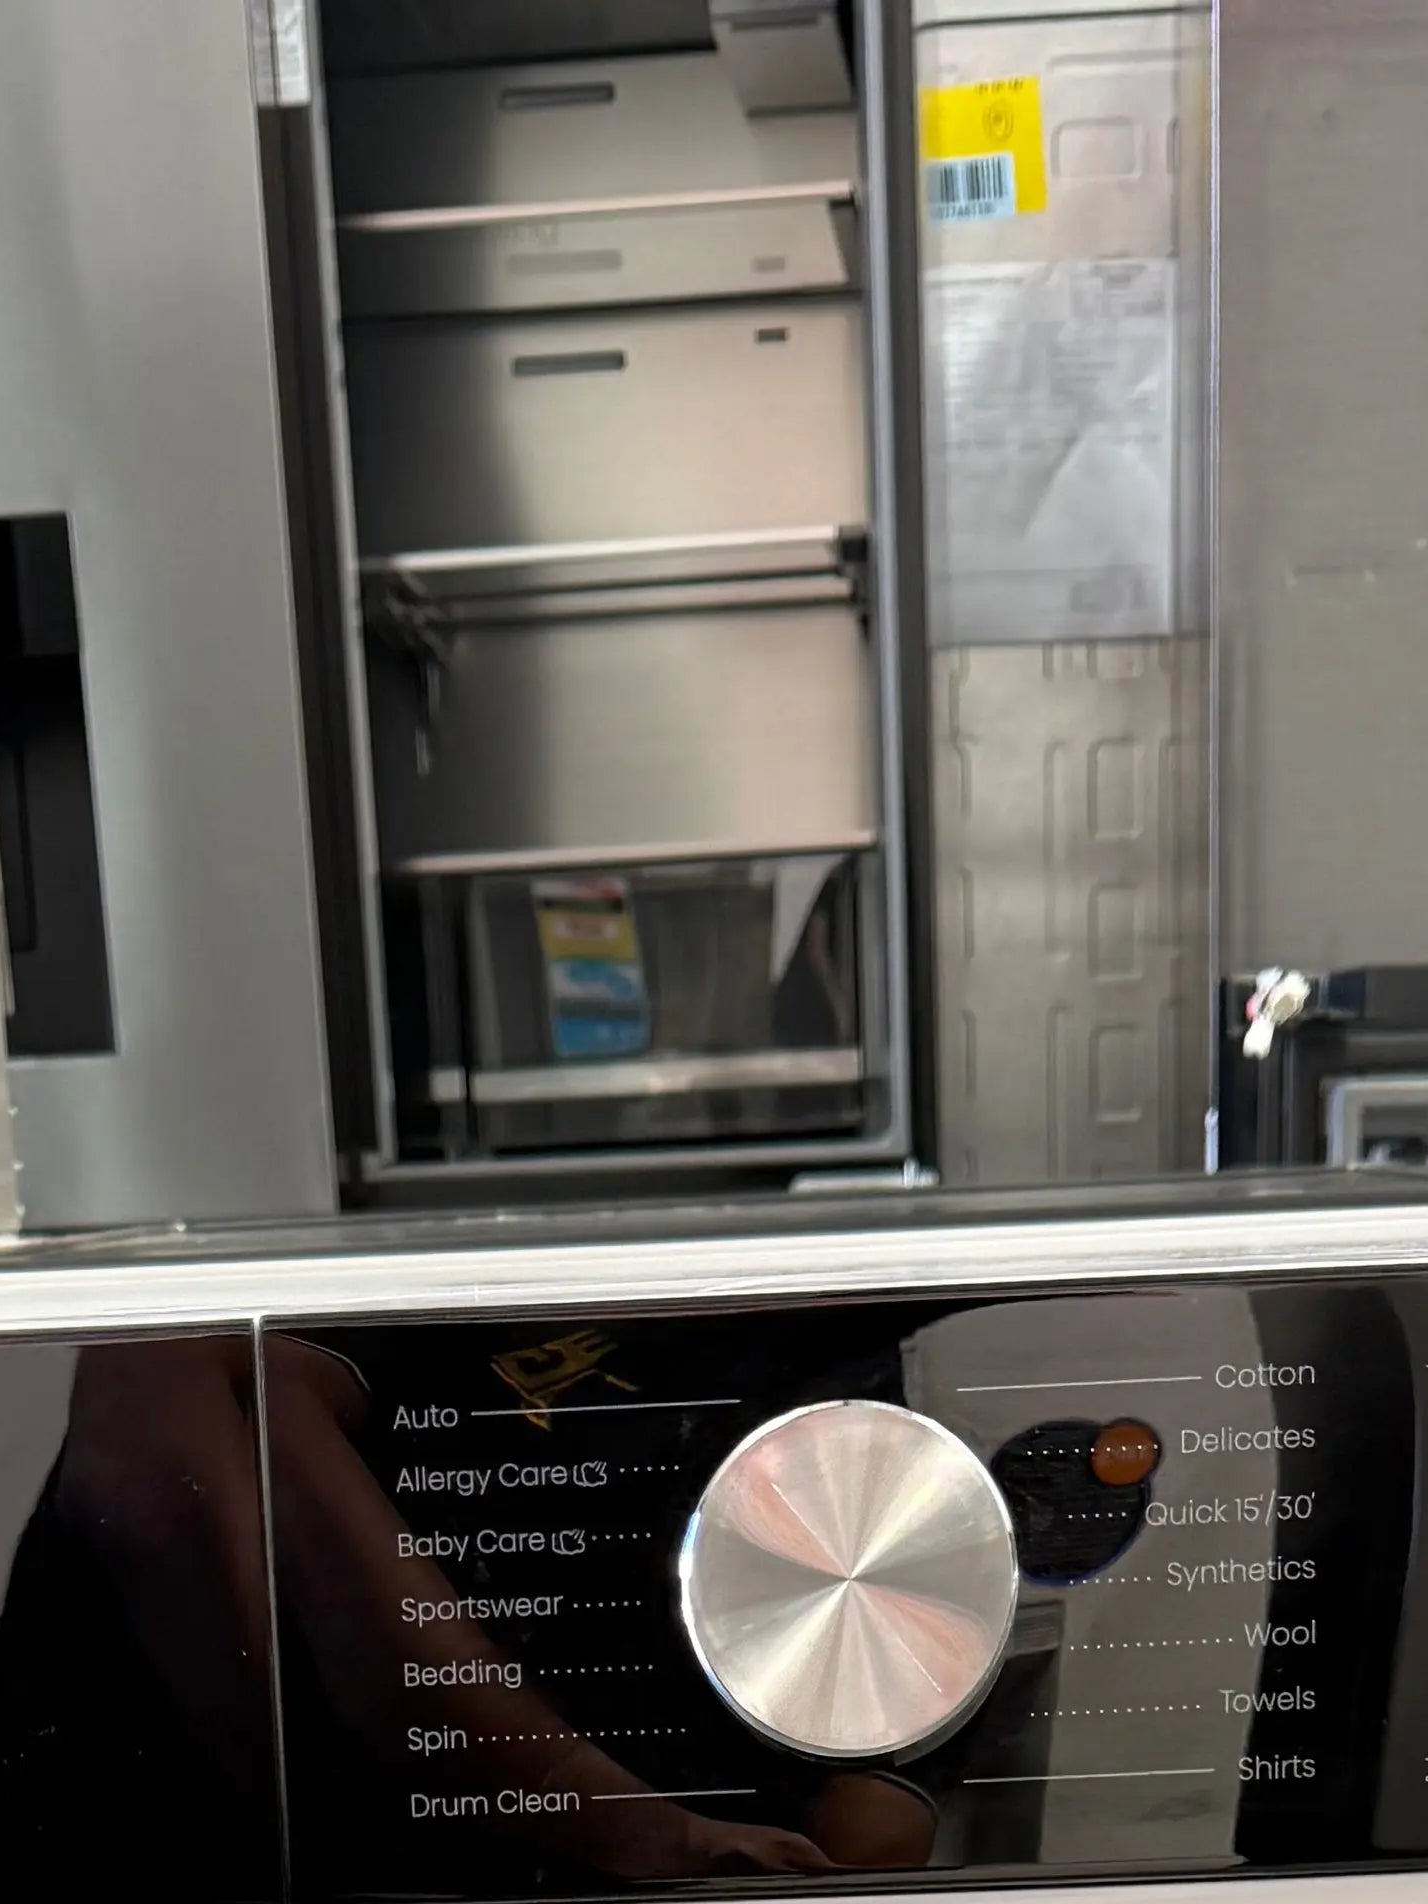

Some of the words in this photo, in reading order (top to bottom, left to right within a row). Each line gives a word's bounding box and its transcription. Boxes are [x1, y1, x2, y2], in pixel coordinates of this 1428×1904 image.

[1215, 1364, 1316, 1389] Cotton
[393, 1405, 458, 1429] Auto
[1180, 1426, 1316, 1454] Delicates
[396, 1466, 490, 1494] Allergy
[498, 1463, 568, 1486] Care
[1145, 1498, 1227, 1528] Quick
[1236, 1493, 1316, 1524] 15'/30'
[397, 1532, 468, 1560] Baby
[477, 1530, 545, 1553] Care
[1166, 1557, 1316, 1591] Synthetics
[401, 1593, 564, 1627] Sportswear
[1244, 1620, 1316, 1646] Wool
[403, 1660, 522, 1688] Bedding
[1220, 1686, 1316, 1714] Towels
[407, 1726, 466, 1755] Spin
[1238, 1755, 1316, 1780] Shirts
[410, 1792, 488, 1817] Drum
[497, 1789, 580, 1813] Clean
